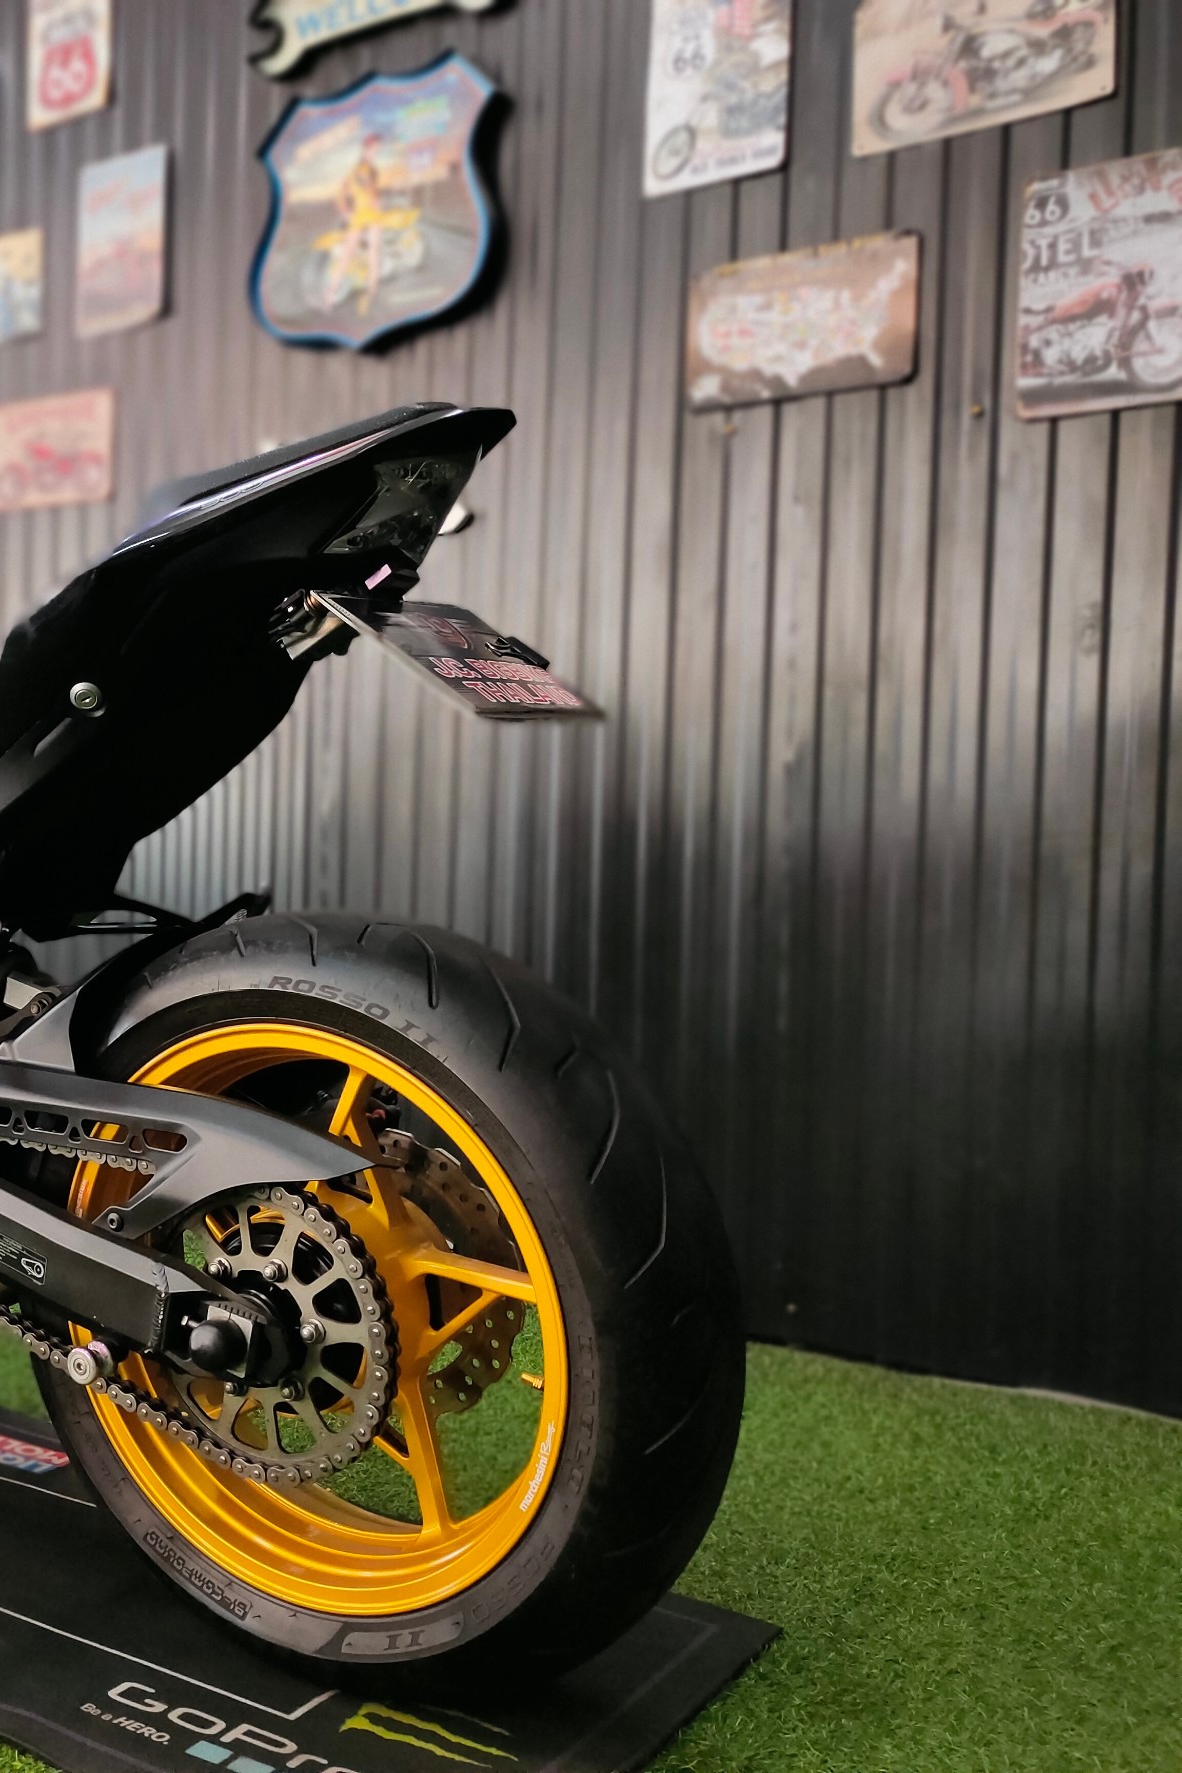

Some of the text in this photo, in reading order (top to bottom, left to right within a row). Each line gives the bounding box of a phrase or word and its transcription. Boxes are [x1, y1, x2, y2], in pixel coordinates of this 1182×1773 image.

[672, 45, 707, 74] 66
[1023, 194, 1061, 225] 66
[462, 681, 581, 705] THAILAND
[267, 975, 391, 1020] ROSSO
[519, 1453, 549, 1512] marchesini
[144, 1530, 248, 1619] BI-COMPOUND
[80, 1703, 171, 1745] Be a HERO.
